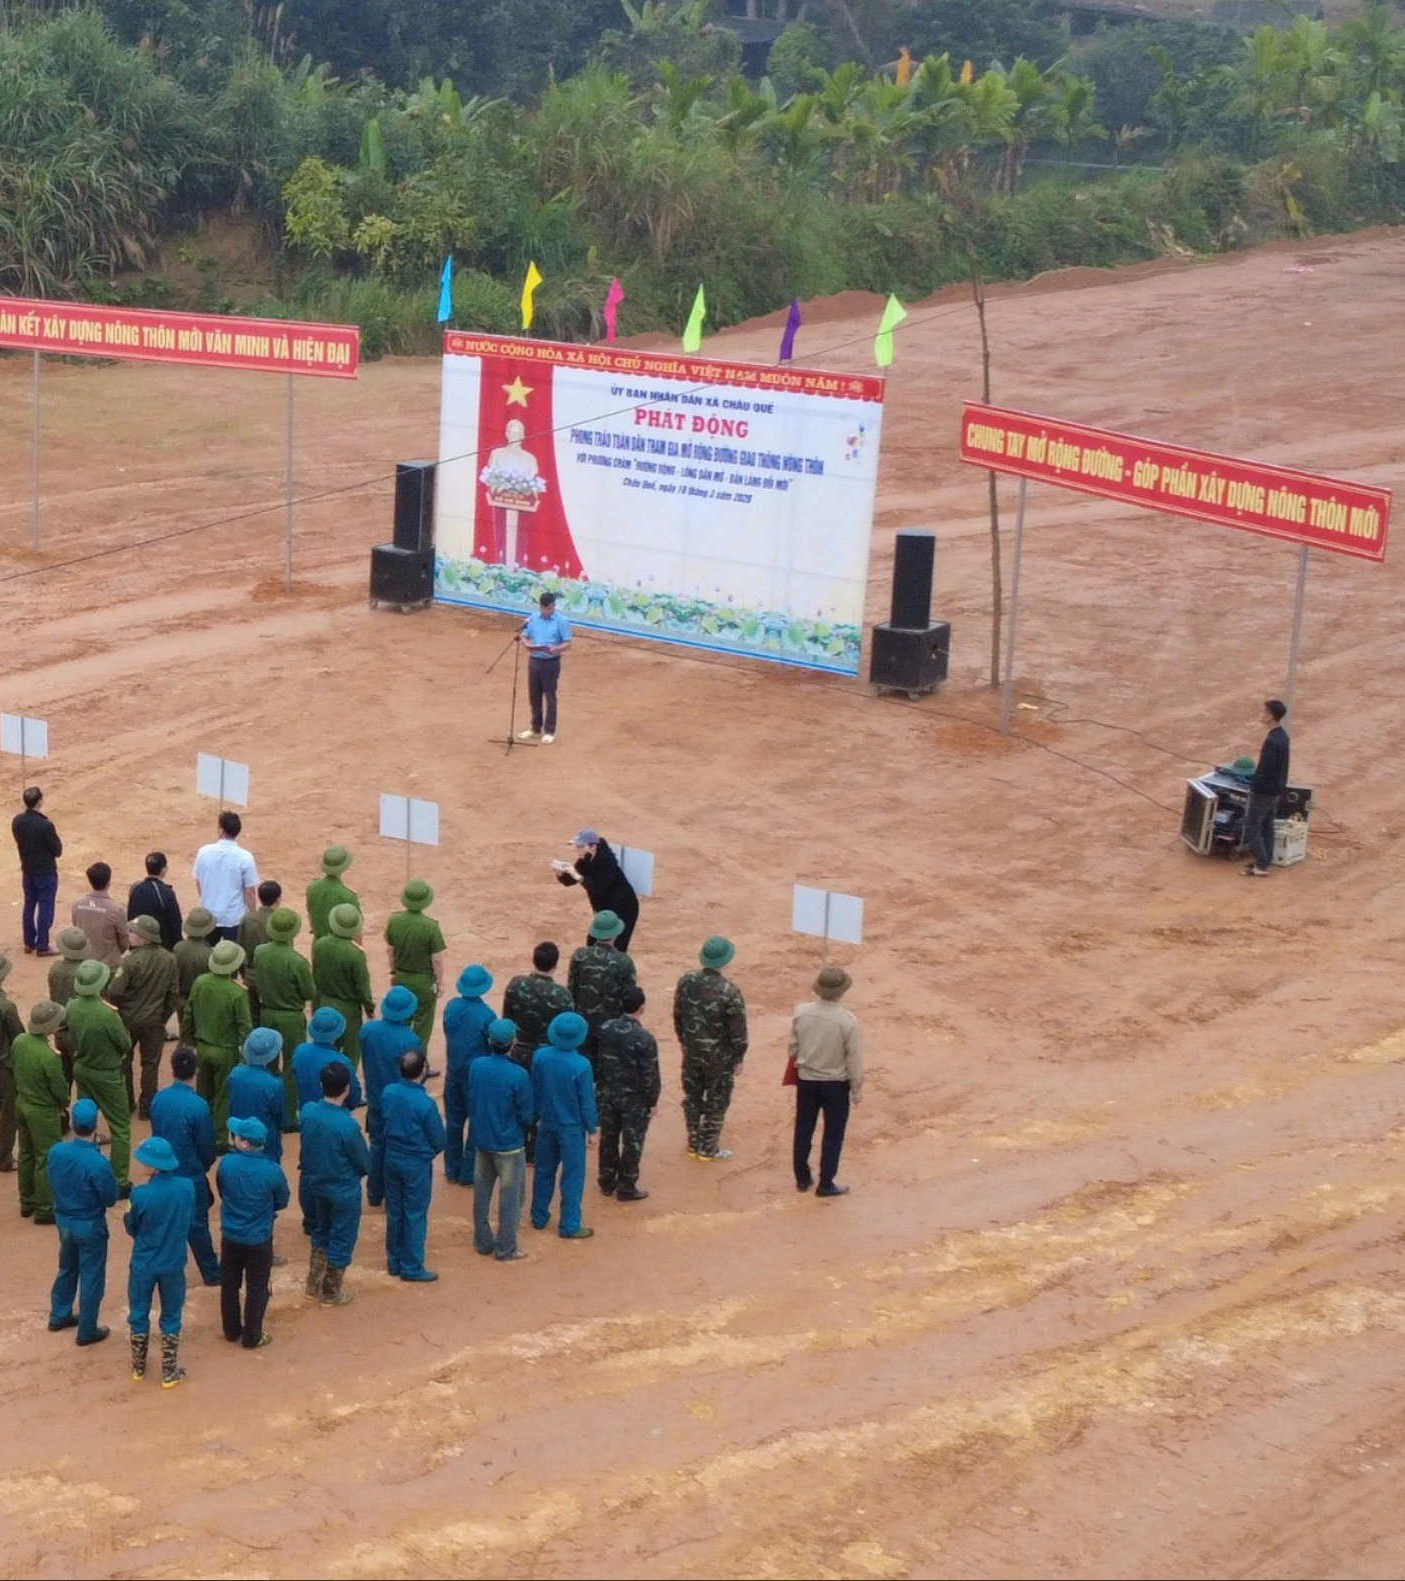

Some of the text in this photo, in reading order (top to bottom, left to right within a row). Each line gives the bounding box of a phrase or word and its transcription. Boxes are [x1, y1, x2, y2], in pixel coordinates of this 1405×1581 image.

[19, 310, 41, 337] KẾT
[43, 314, 66, 340] XÂY
[69, 319, 102, 346] DỰNG
[105, 320, 139, 346] NÔNG
[142, 324, 175, 350] THÔN
[178, 326, 203, 352] MỚI
[206, 329, 232, 355] VĂN
[235, 334, 270, 358] MINH
[273, 334, 289, 360] VÀ
[293, 336, 323, 366] HIỆN
[327, 341, 351, 369] ĐẠI
[466, 338, 498, 353] NƯỚC
[500, 341, 534, 358] CỘNG
[537, 344, 563, 361] HÒA
[566, 349, 584, 363] XÃ
[588, 350, 611, 367] HỘI
[614, 354, 642, 370] CHỦ
[645, 357, 687, 375] NGHĨA
[691, 362, 723, 379] VIỆT
[725, 368, 758, 382] NAM
[760, 372, 803, 387] MUÔN
[805, 377, 838, 392] NĂM
[611, 384, 774, 414] ỦY BAN NHÂN DÂN XÃ CHÂU QUẾ
[631, 433, 645, 452] DÂN
[647, 438, 666, 455] THAM
[634, 407, 749, 439] PHÁT ĐỘNG
[967, 422, 1005, 454] CHUNG
[1007, 431, 1026, 458] TAY
[1027, 430, 1048, 464] MỞ
[1047, 437, 1081, 473] RỘNG
[1082, 446, 1123, 482] ĐƯỜNG
[1125, 469, 1131, 477] -
[1133, 456, 1160, 490] GÓP
[1198, 470, 1226, 505] XÂY
[1227, 481, 1265, 516] DỰNG
[1266, 485, 1307, 523] NÔNG
[1309, 496, 1347, 533] THÔN
[1349, 504, 1380, 541] MỚI
